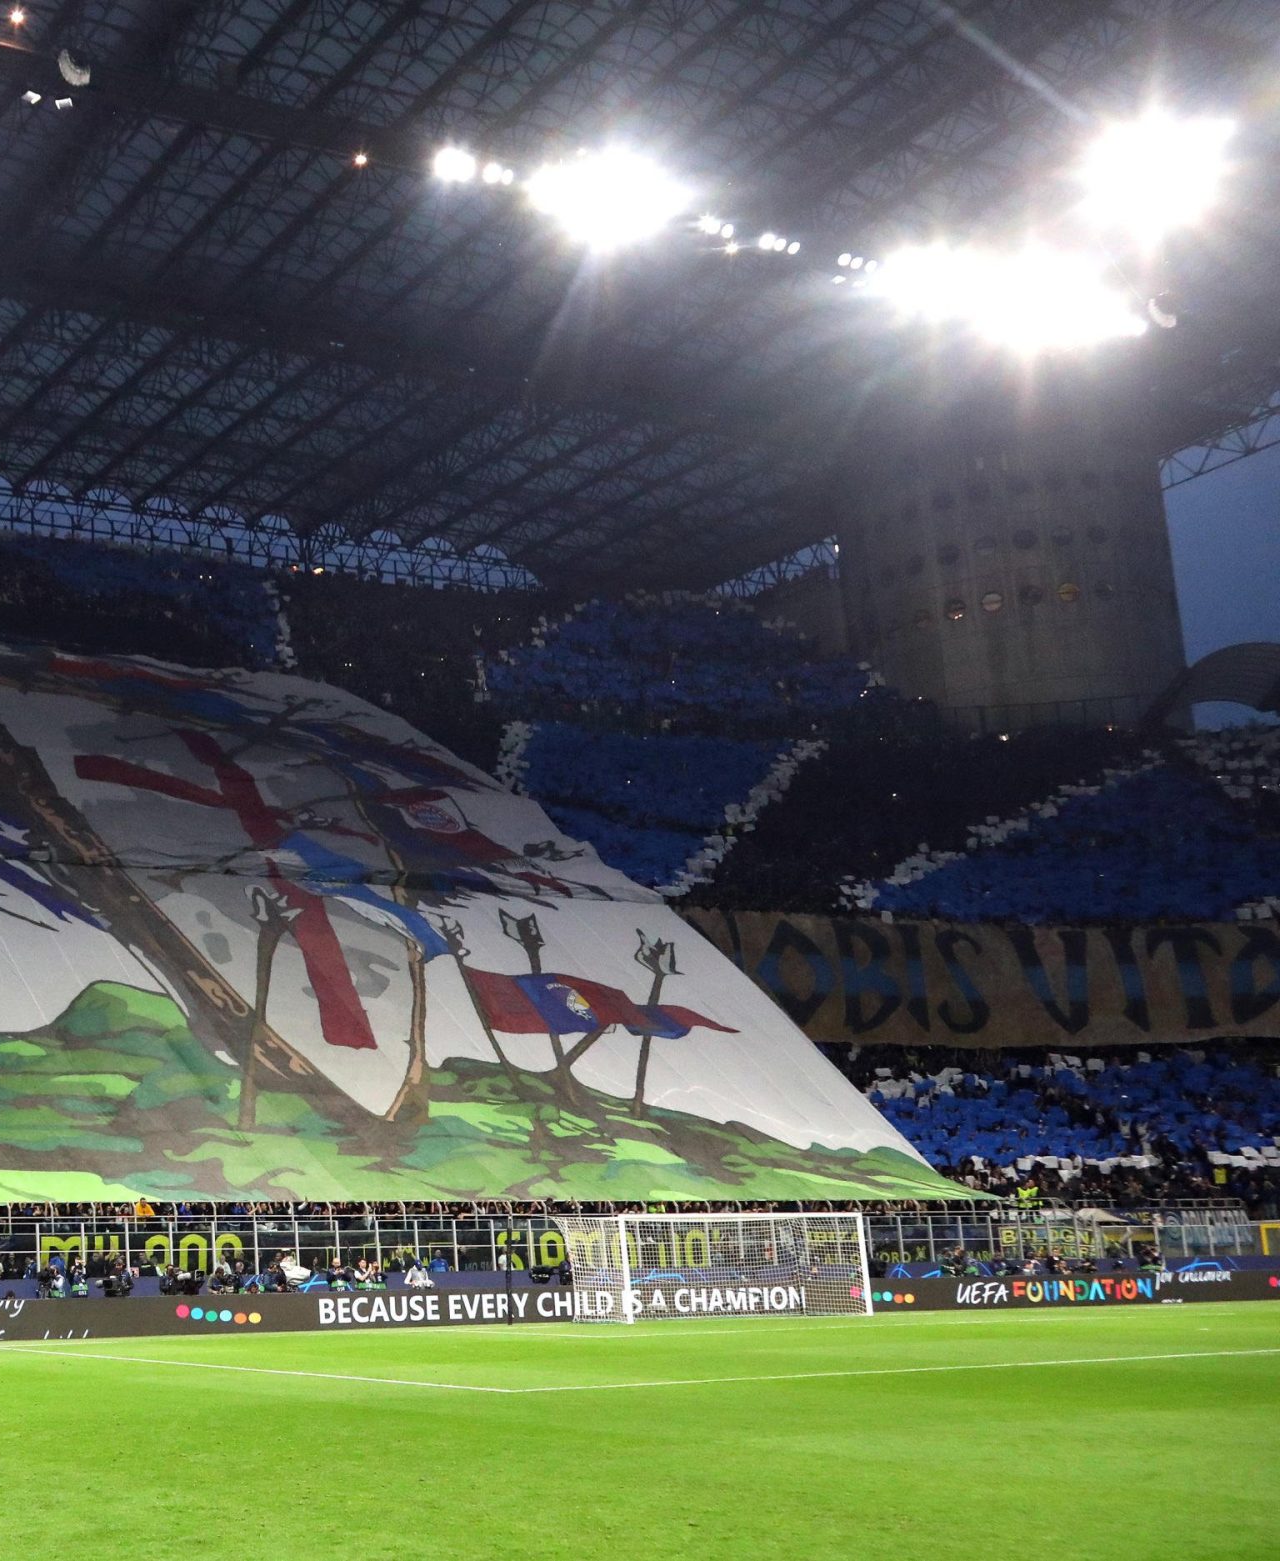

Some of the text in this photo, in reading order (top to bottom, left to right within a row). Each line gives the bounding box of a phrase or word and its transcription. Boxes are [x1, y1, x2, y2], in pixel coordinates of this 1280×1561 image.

[319, 1295, 440, 1324] BECAUSE
[449, 1293, 528, 1319] EVERY
[537, 1290, 613, 1318] CHILD
[674, 1286, 805, 1312] CHAMPION
[956, 1282, 1009, 1304] UEFA
[1012, 1278, 1153, 1303] FOUNDATION
